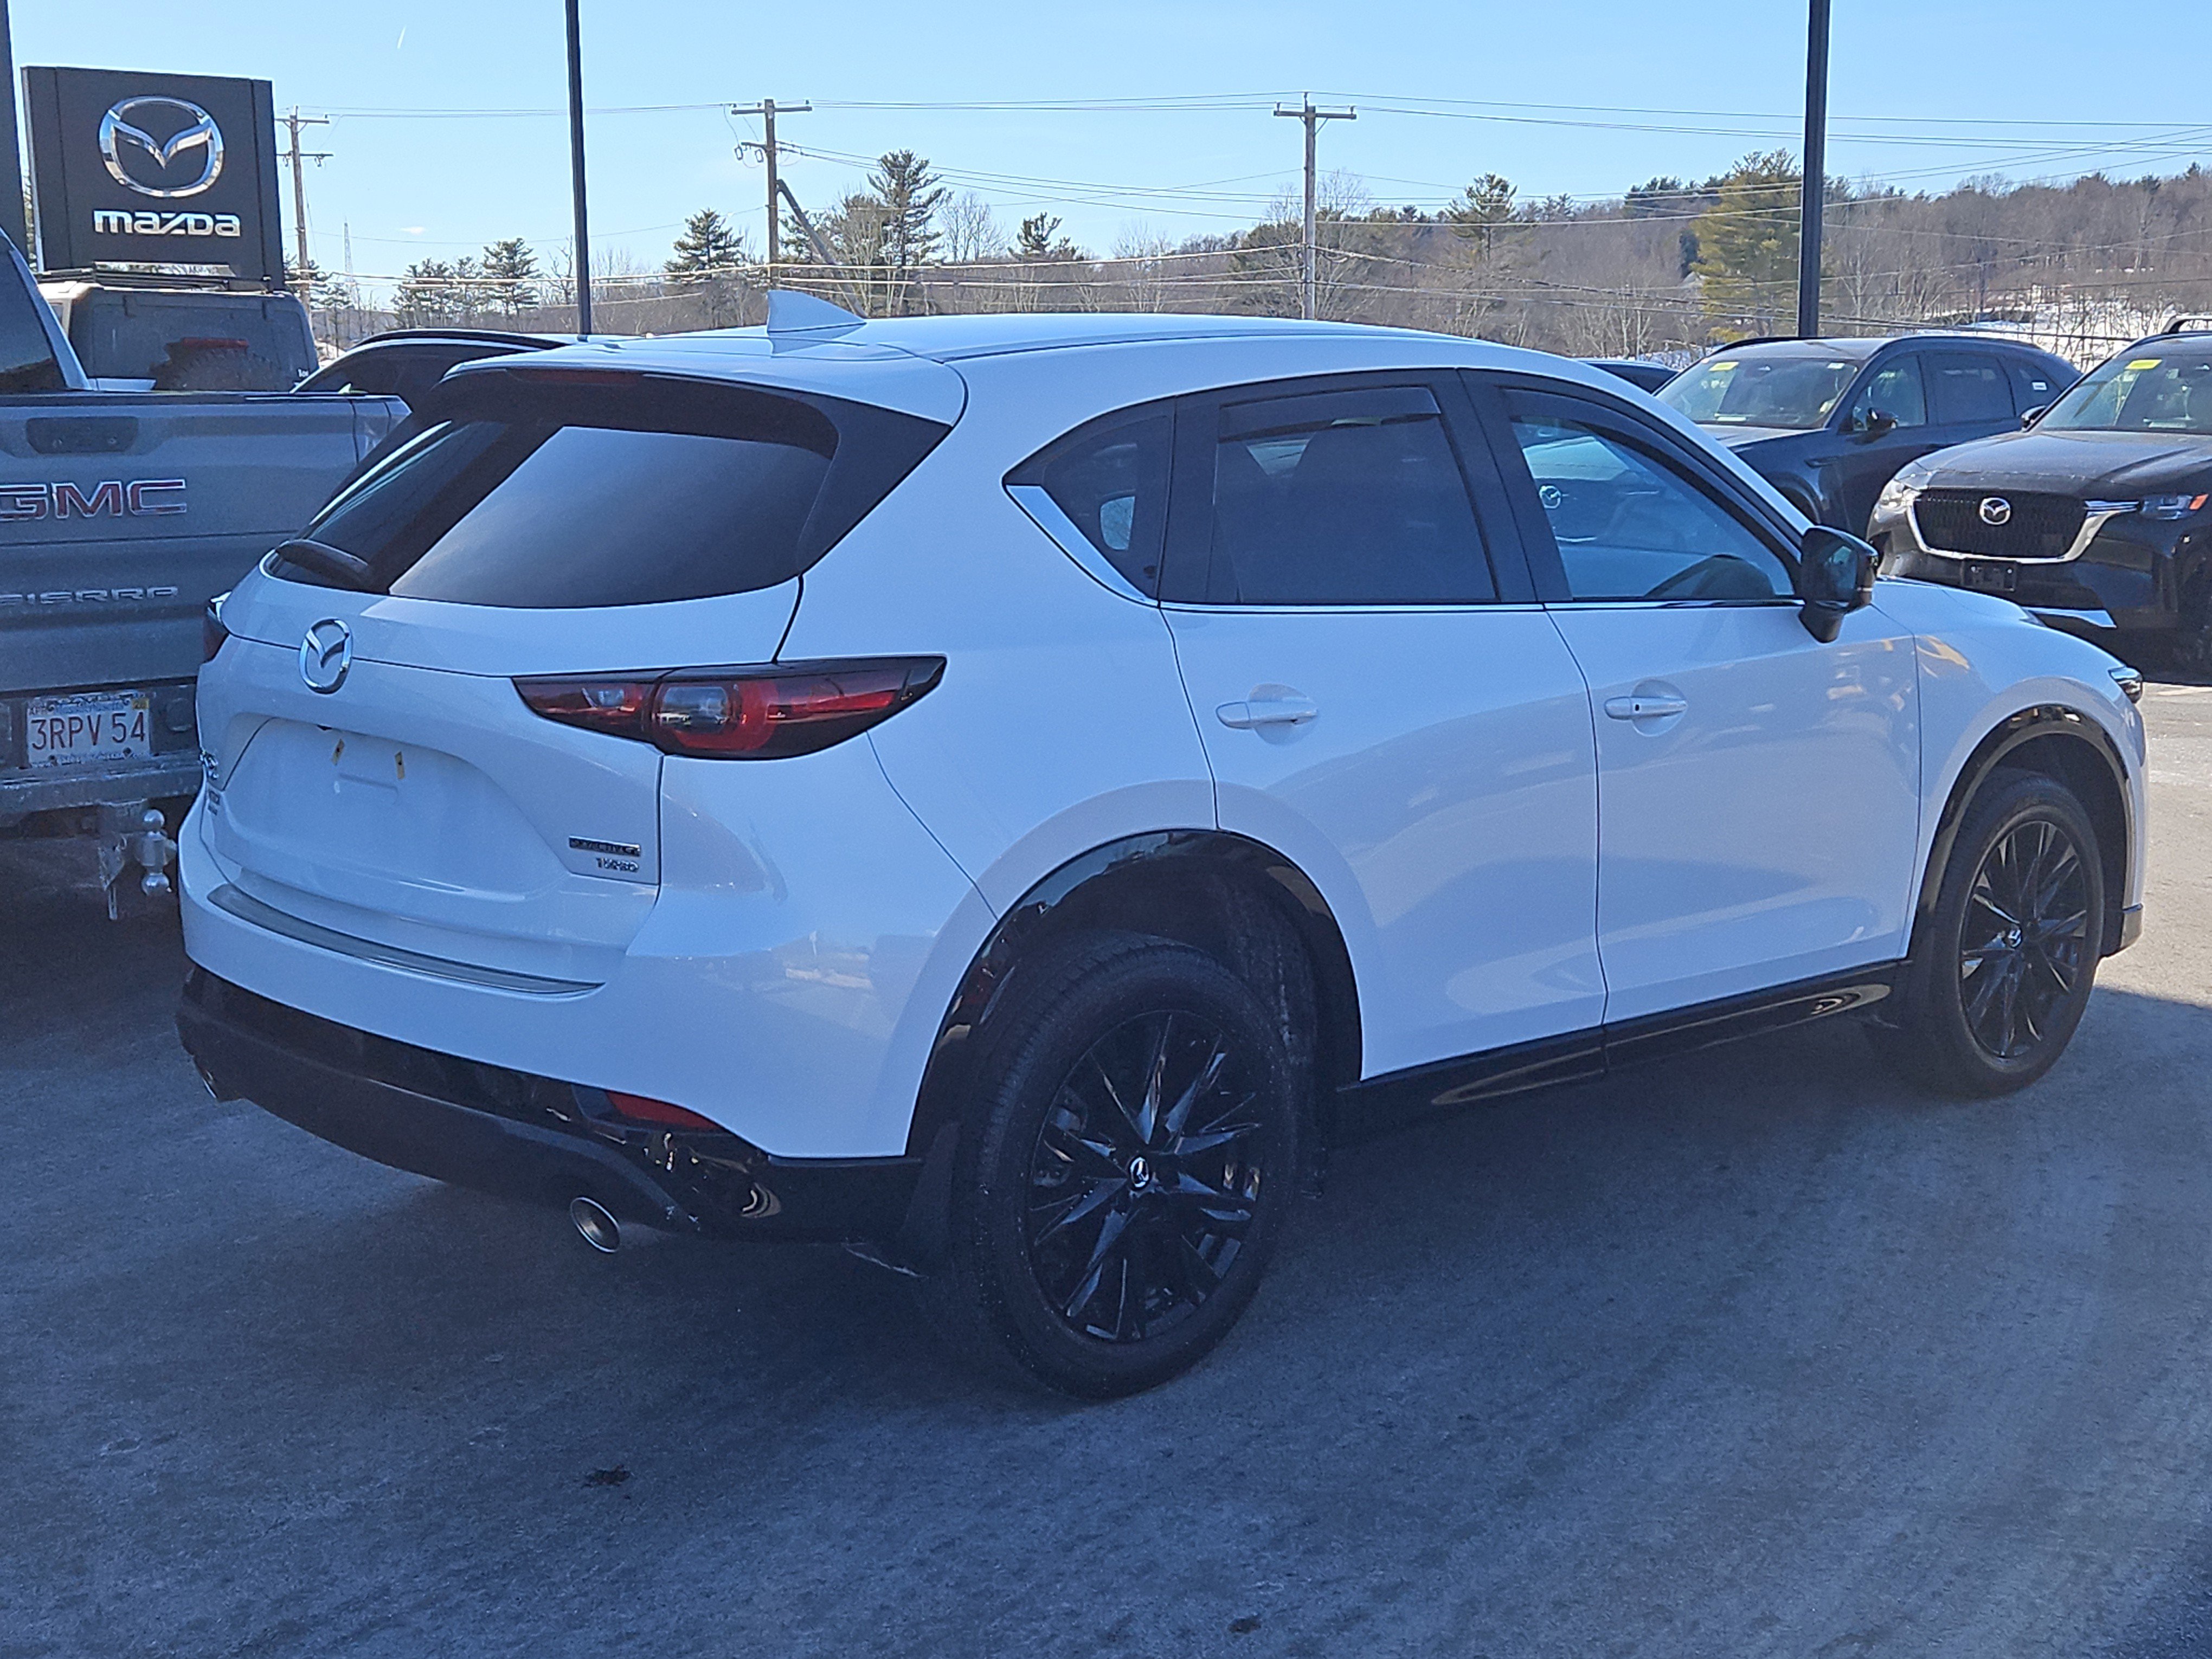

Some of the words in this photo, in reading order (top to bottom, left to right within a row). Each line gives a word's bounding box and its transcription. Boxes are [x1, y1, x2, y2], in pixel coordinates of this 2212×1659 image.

[93, 209, 241, 237] mazda
[0, 479, 187, 522] GMC
[31, 713, 102, 750] 3RPV
[112, 711, 145, 743] 54
